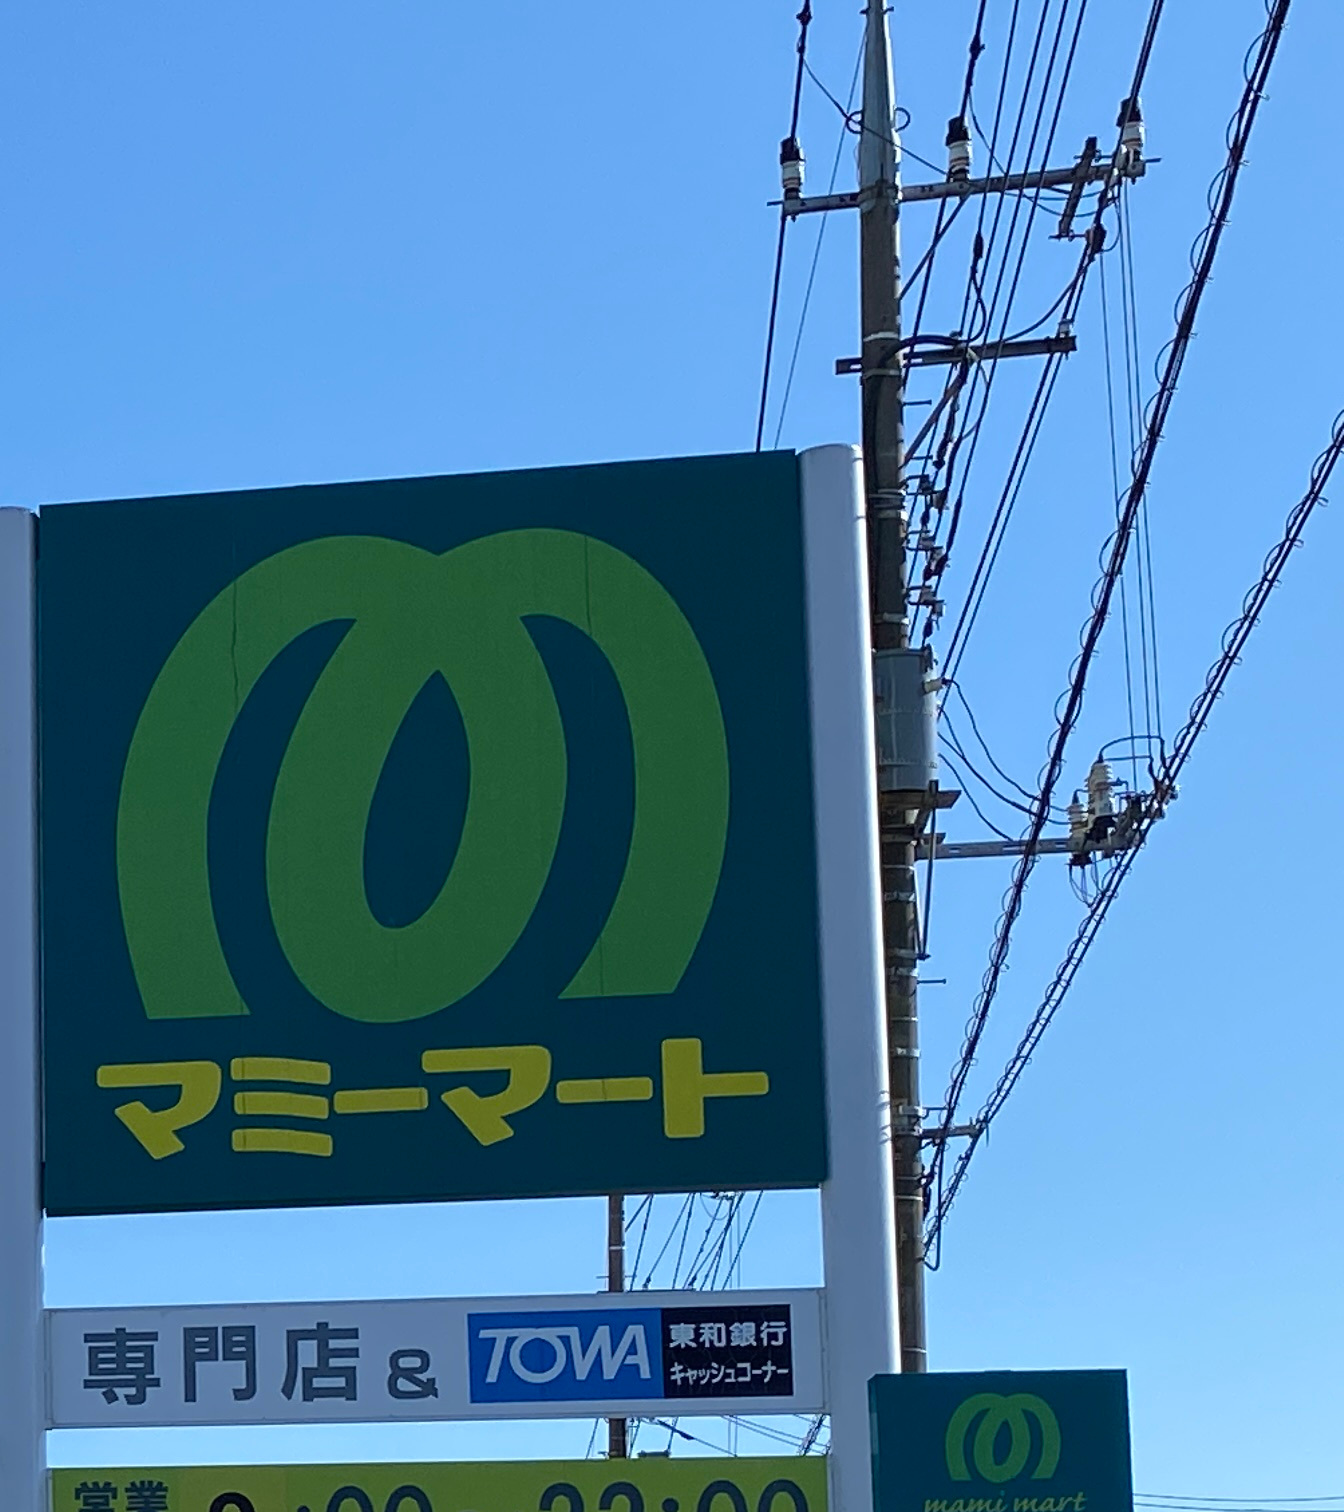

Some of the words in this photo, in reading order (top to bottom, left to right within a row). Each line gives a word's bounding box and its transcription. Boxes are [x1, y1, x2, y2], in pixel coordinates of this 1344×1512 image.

[97, 1037, 769, 1160] マミーマート
[83, 1321, 360, 1405] 専門店
[387, 1347, 439, 1401] &
[478, 1324, 652, 1384] TOWA
[668, 1321, 788, 1349] 東和銀行
[669, 1359, 790, 1387] キャッシュコーナー
